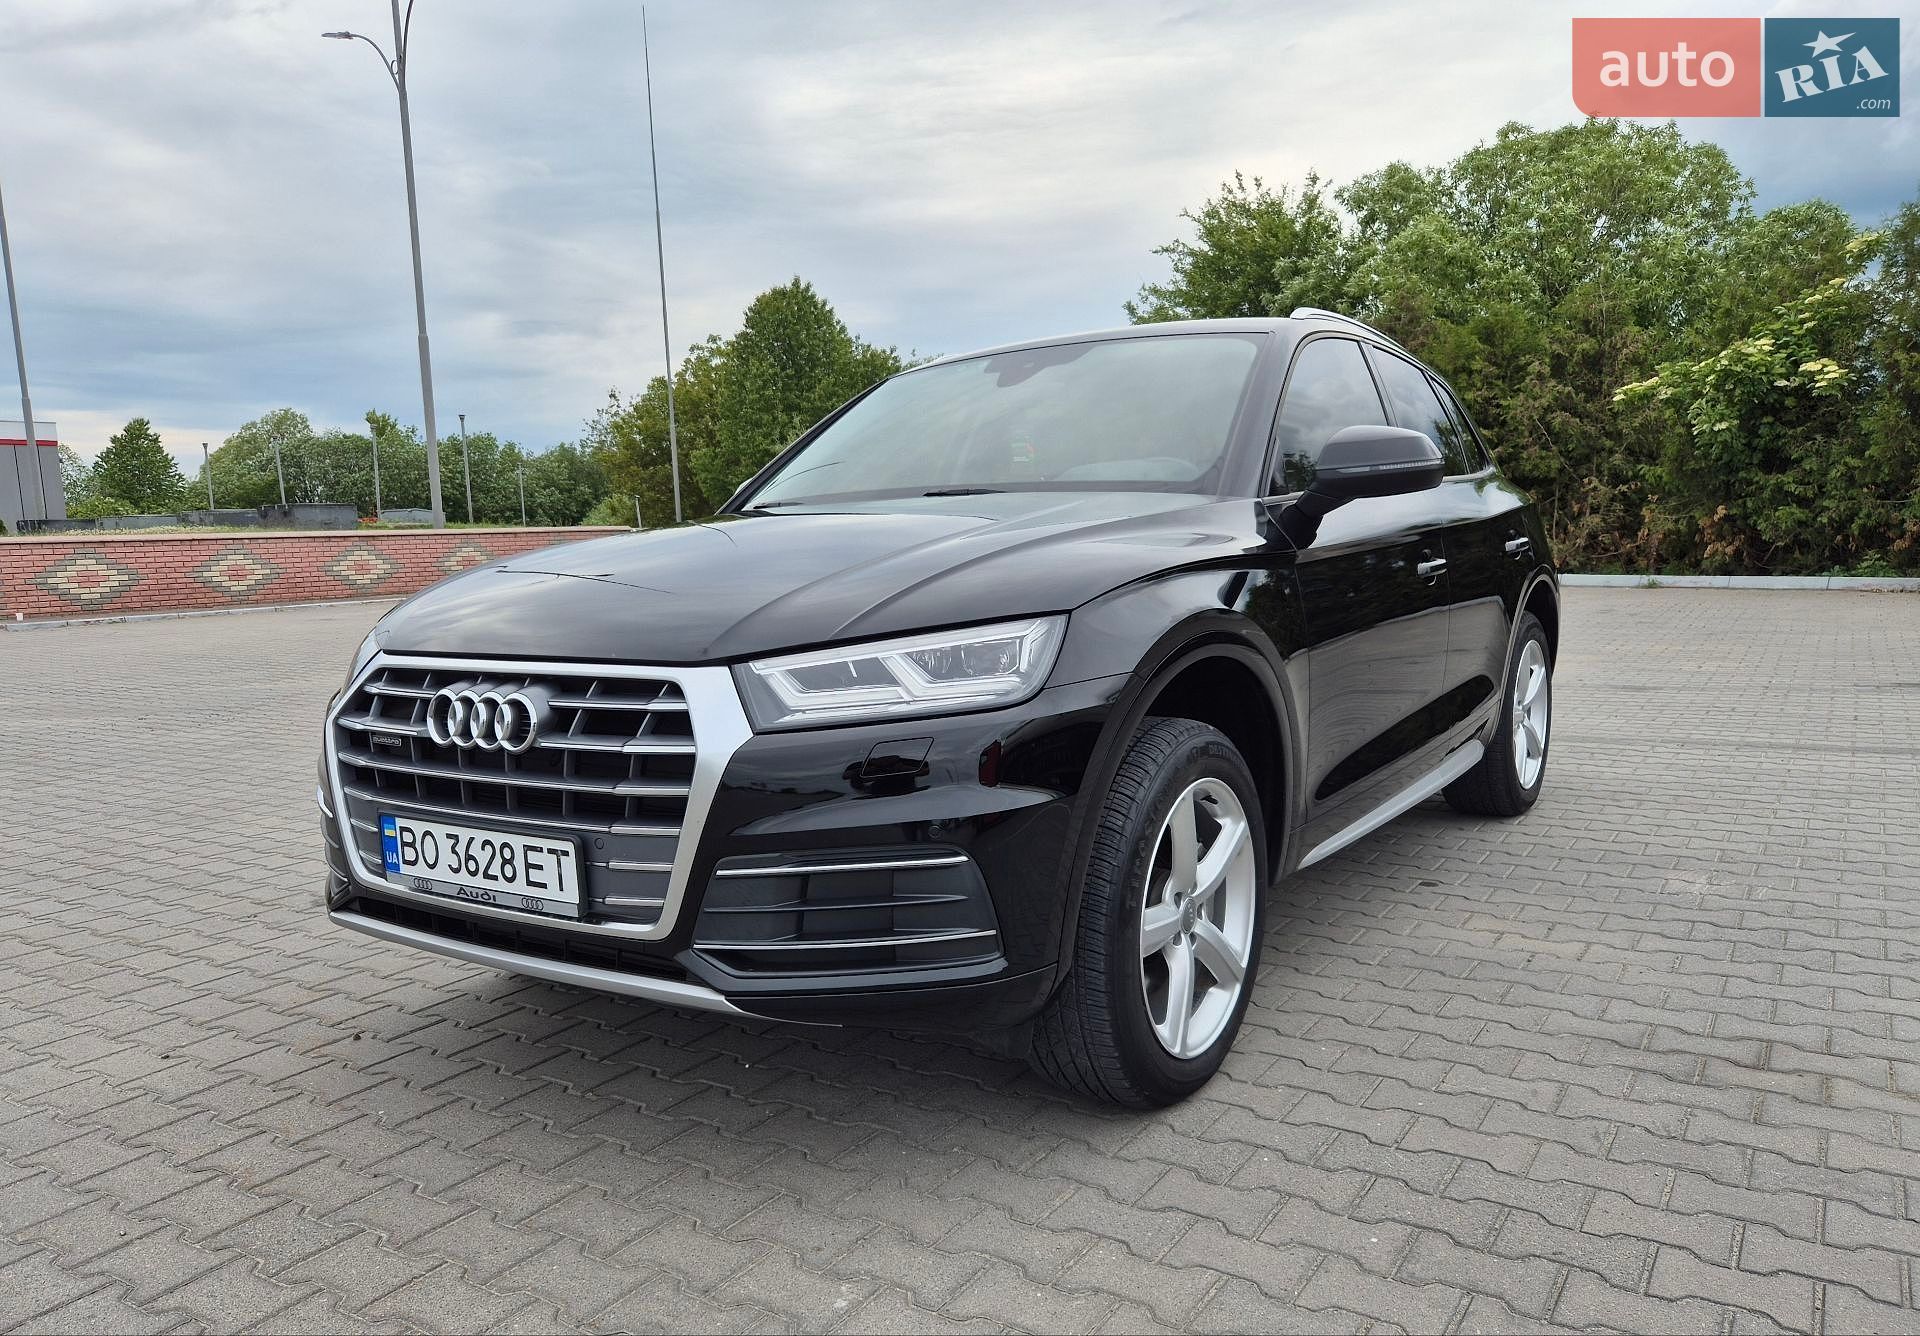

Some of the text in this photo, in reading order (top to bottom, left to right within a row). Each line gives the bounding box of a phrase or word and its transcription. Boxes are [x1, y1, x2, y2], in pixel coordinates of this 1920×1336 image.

[386, 851, 398, 864] UA
[399, 825, 570, 892] BO 3628 ET
[456, 886, 497, 902] Audi
